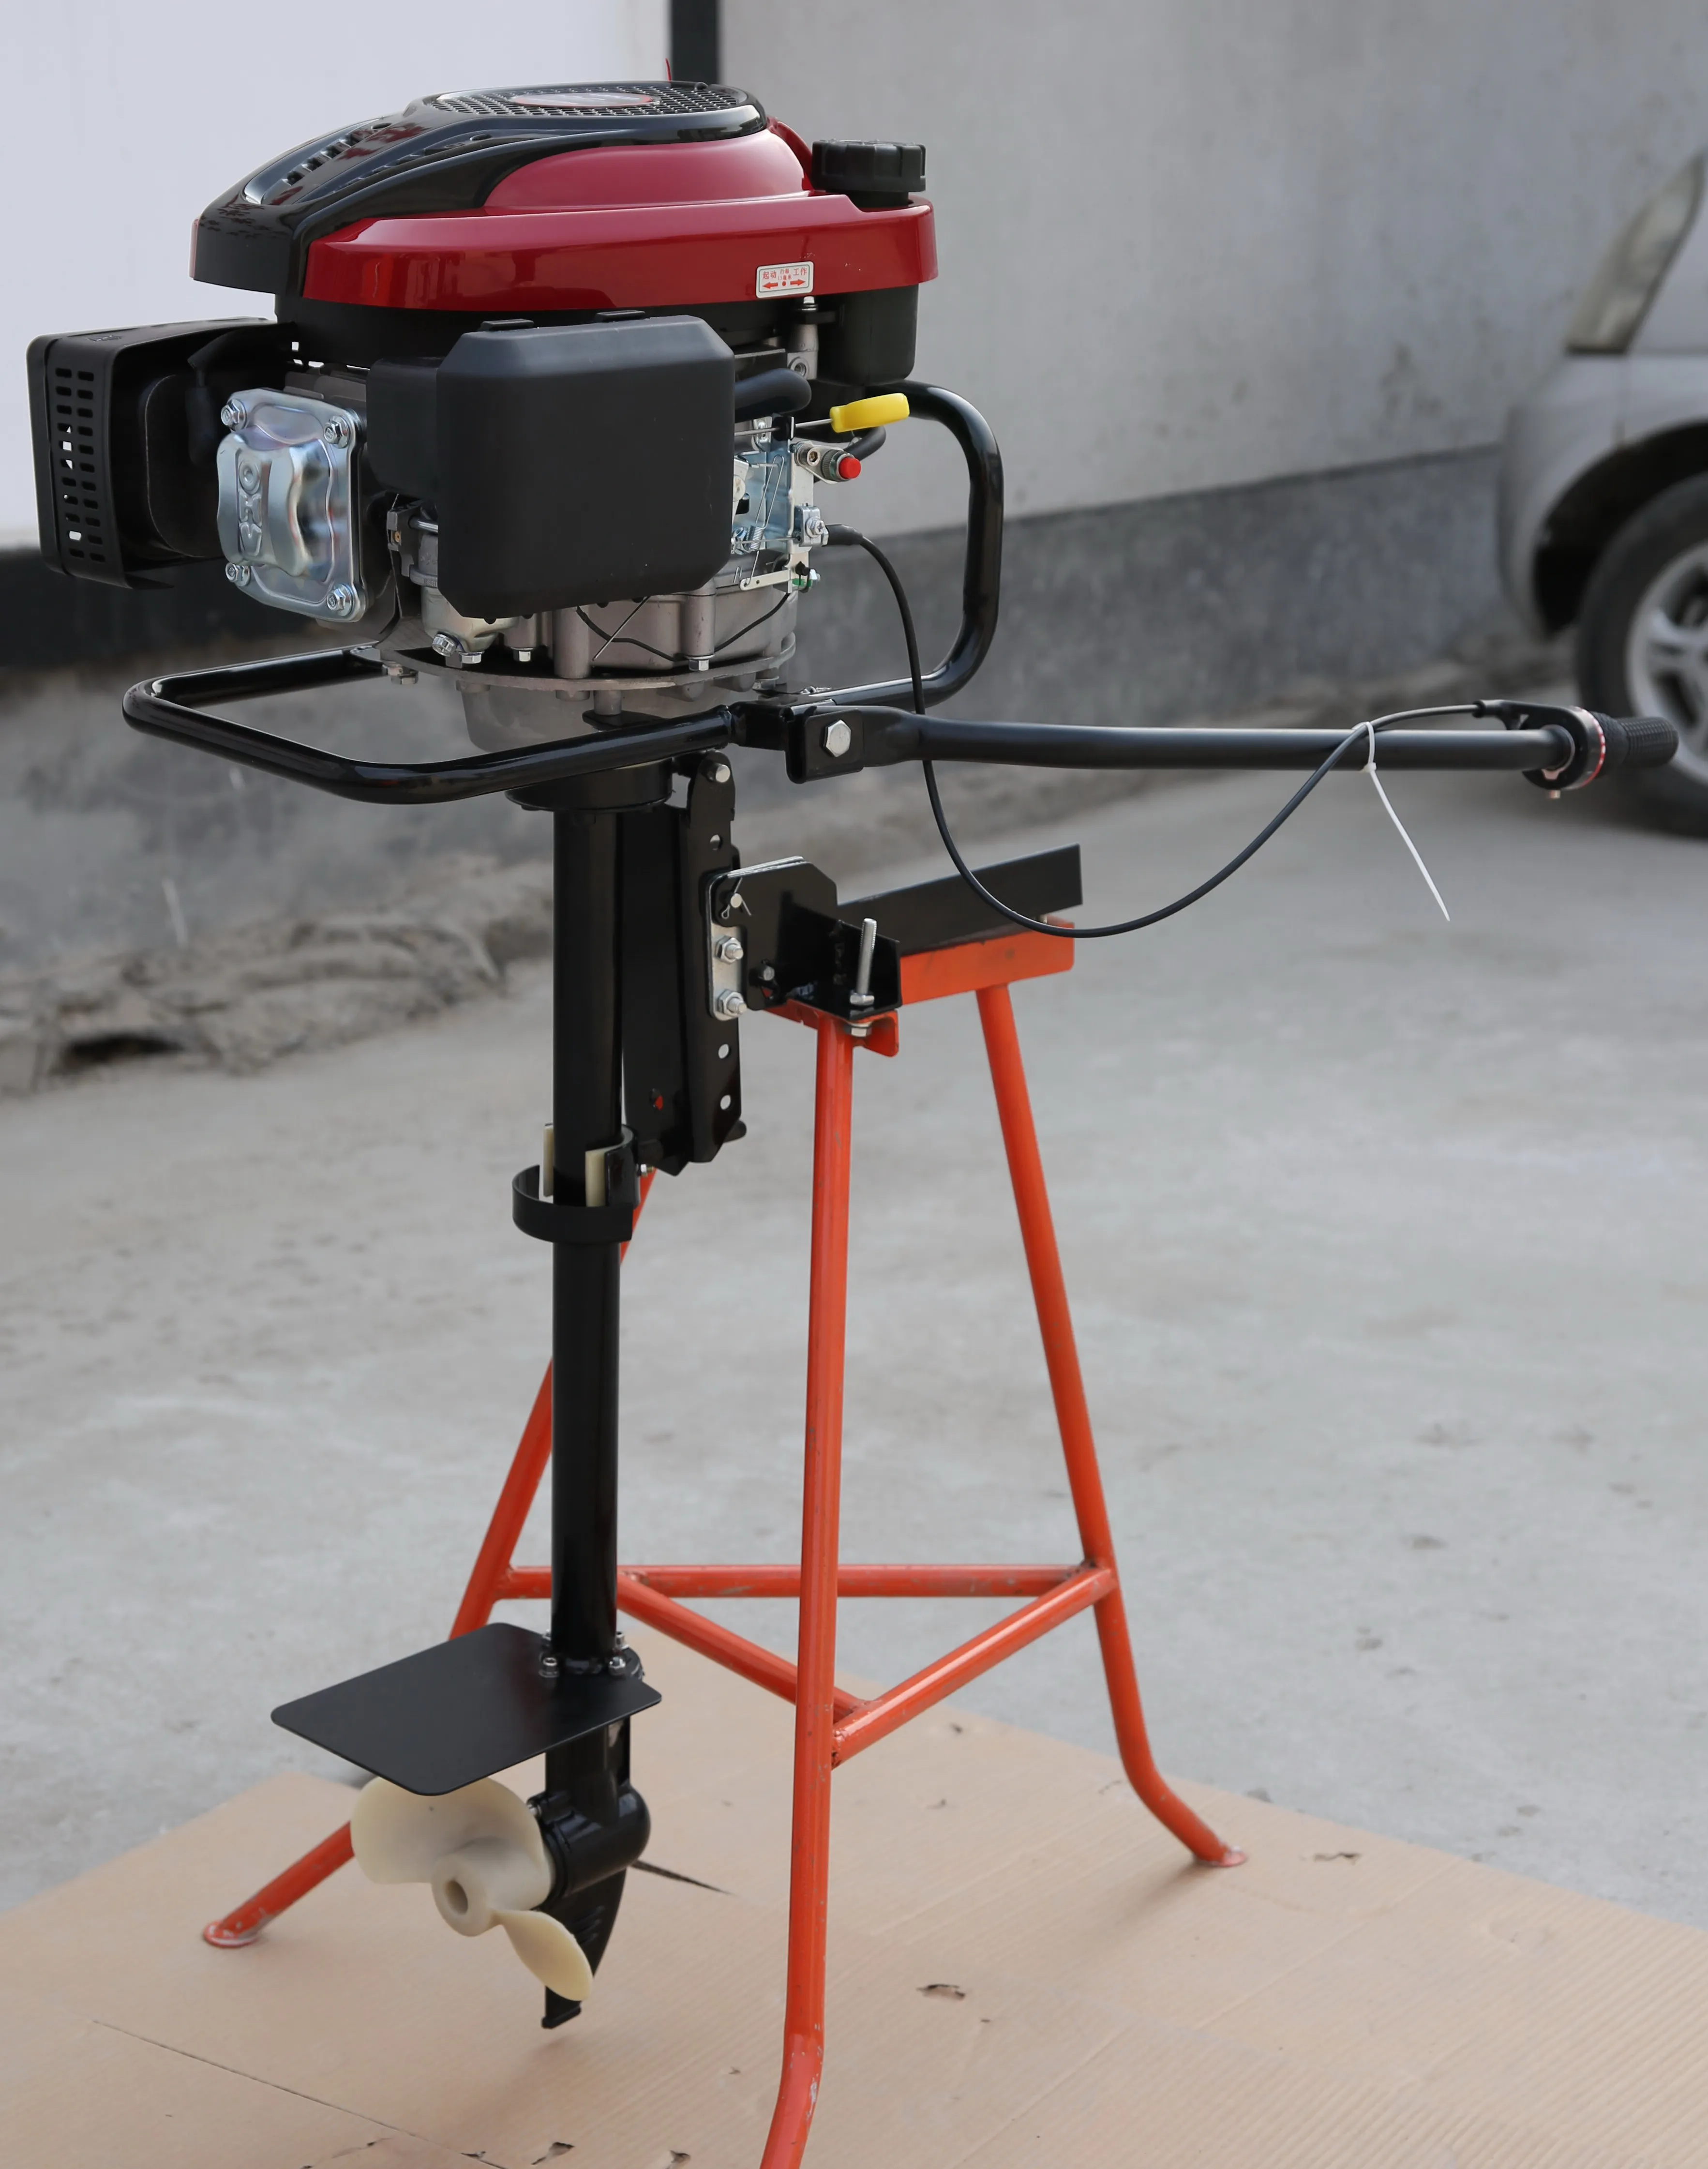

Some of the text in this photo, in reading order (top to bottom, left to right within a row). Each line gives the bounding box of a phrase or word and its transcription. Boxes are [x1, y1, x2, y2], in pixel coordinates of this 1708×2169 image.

[763, 270, 777, 279] 起动
[793, 267, 807, 276] 工作
[239, 460, 262, 557] OHV
